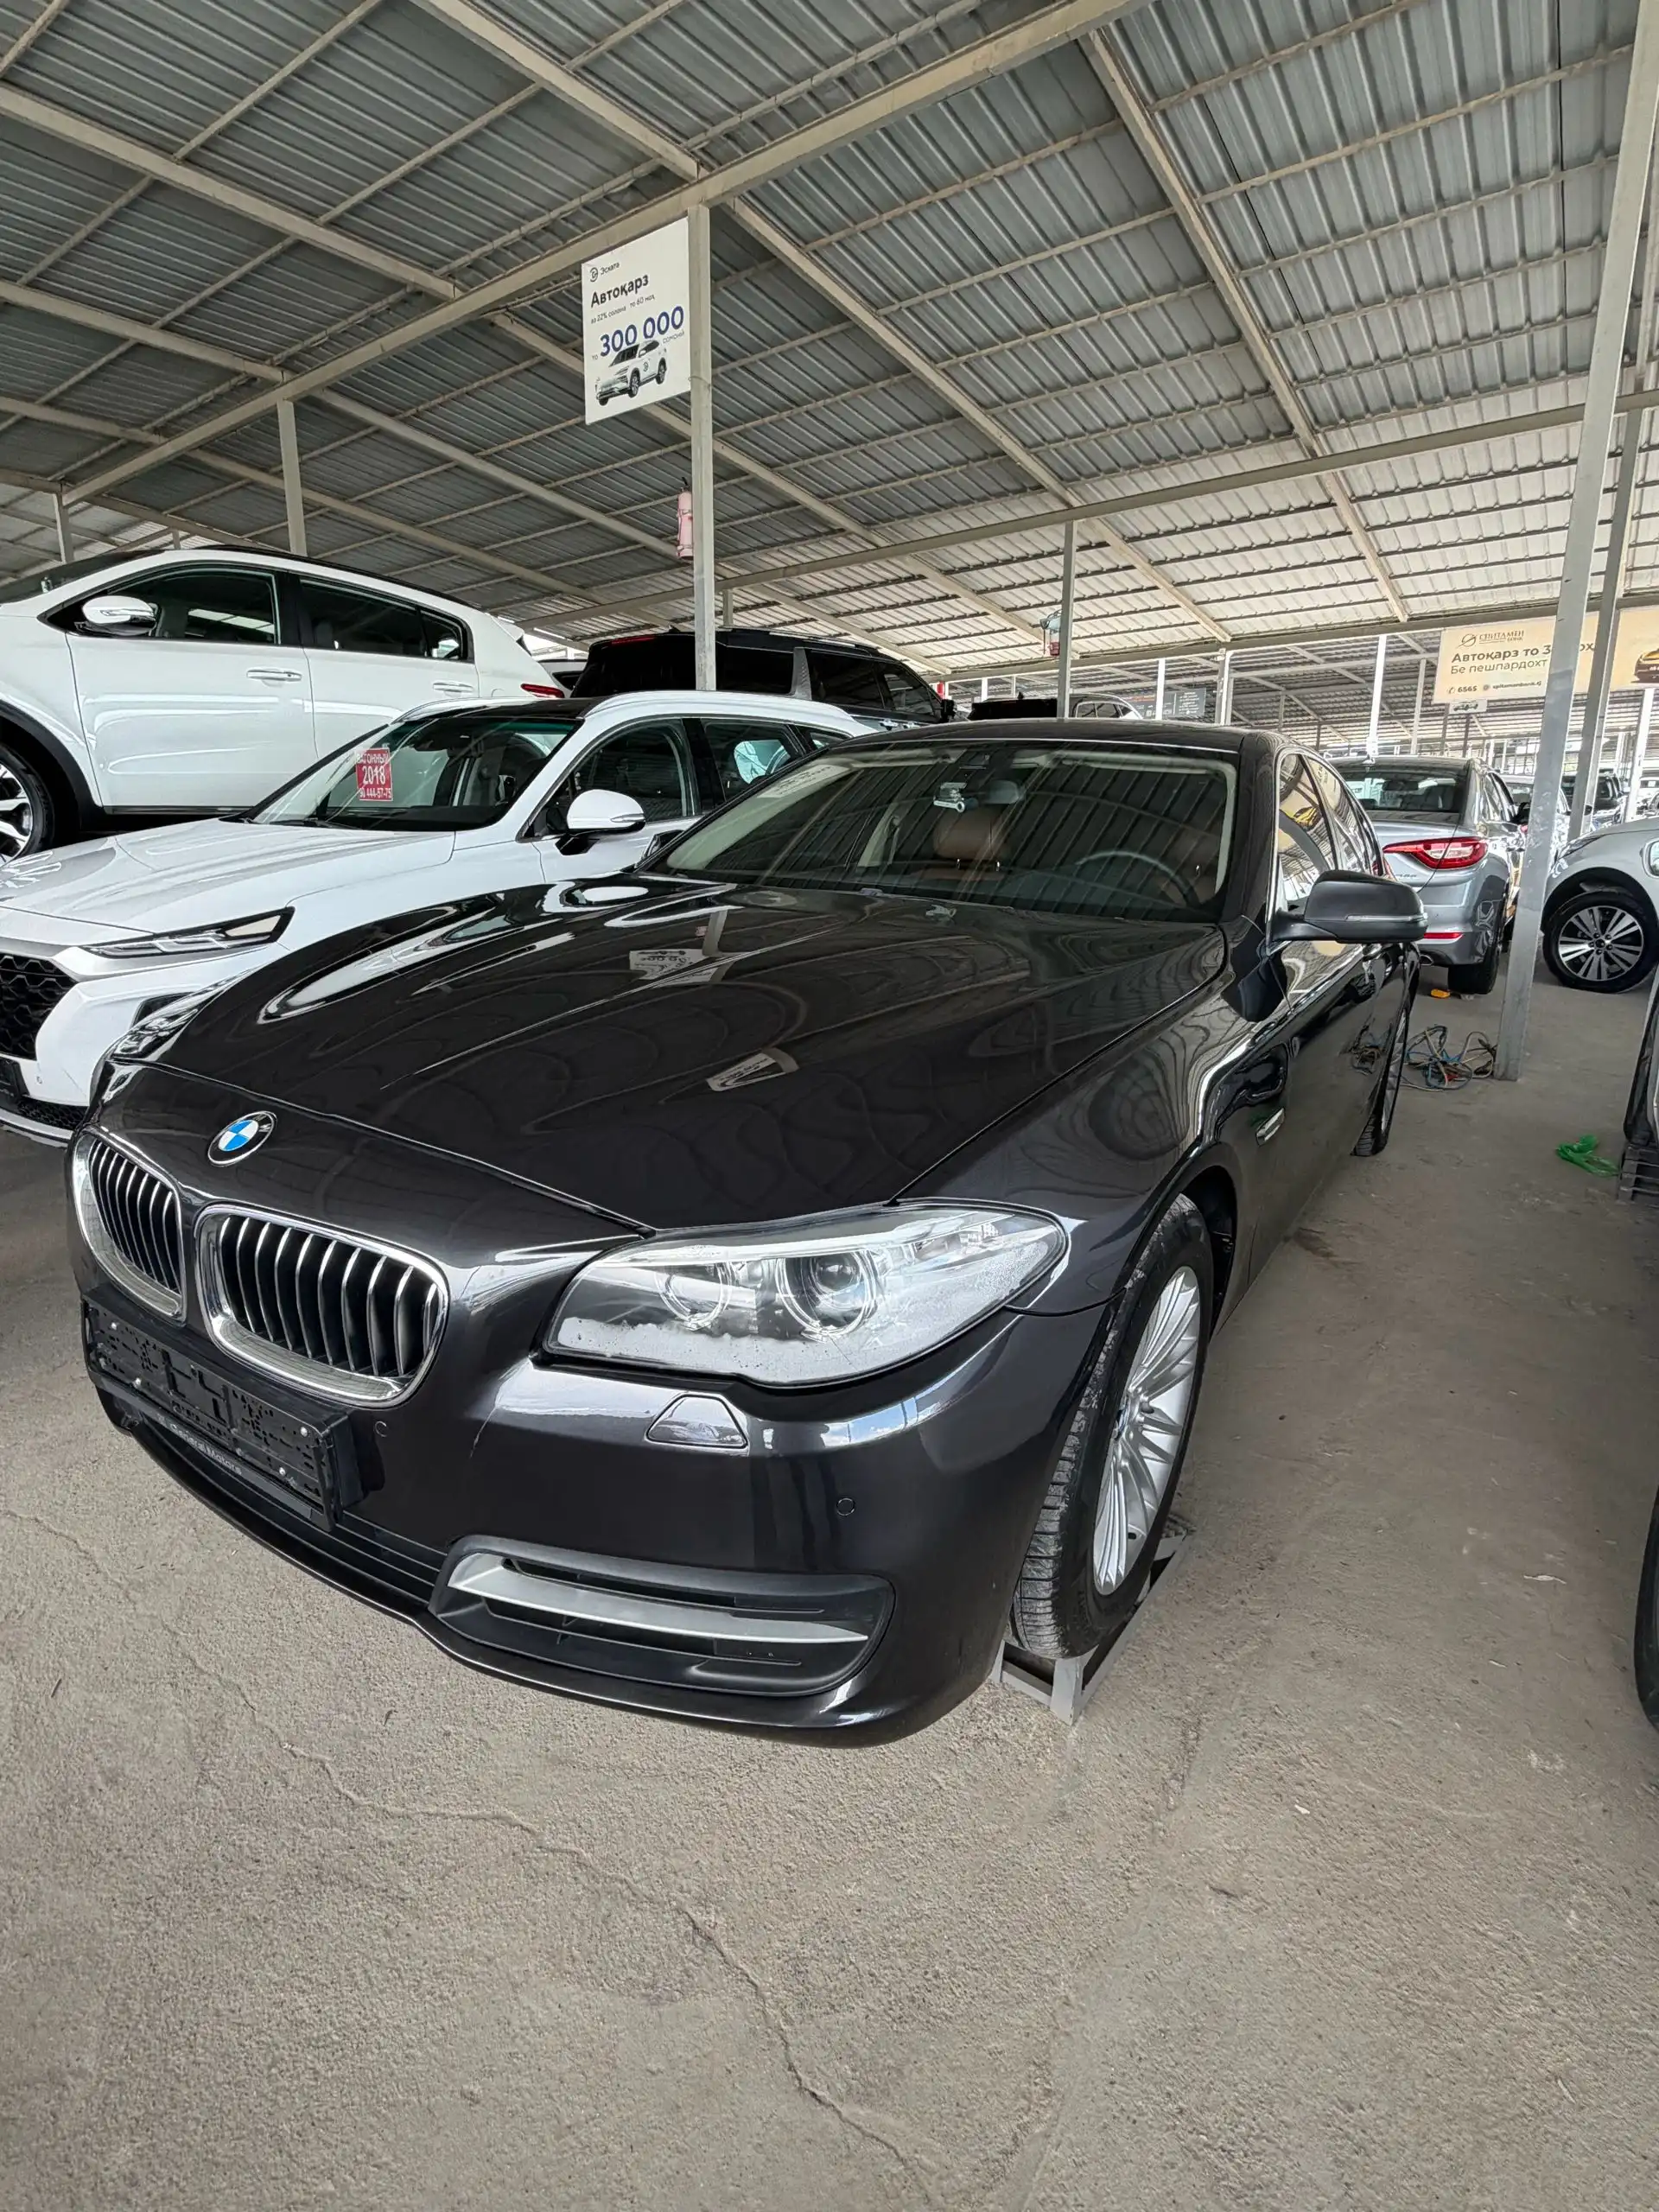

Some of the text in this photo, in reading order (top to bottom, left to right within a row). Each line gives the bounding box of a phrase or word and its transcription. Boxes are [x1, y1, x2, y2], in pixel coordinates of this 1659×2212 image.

[590, 274, 650, 308] Автоқарз
[600, 305, 684, 358] 300 000
[1523, 647, 1539, 658] то
[1450, 658, 1549, 675] Бе пешпардохт
[362, 766, 386, 785] 2018
